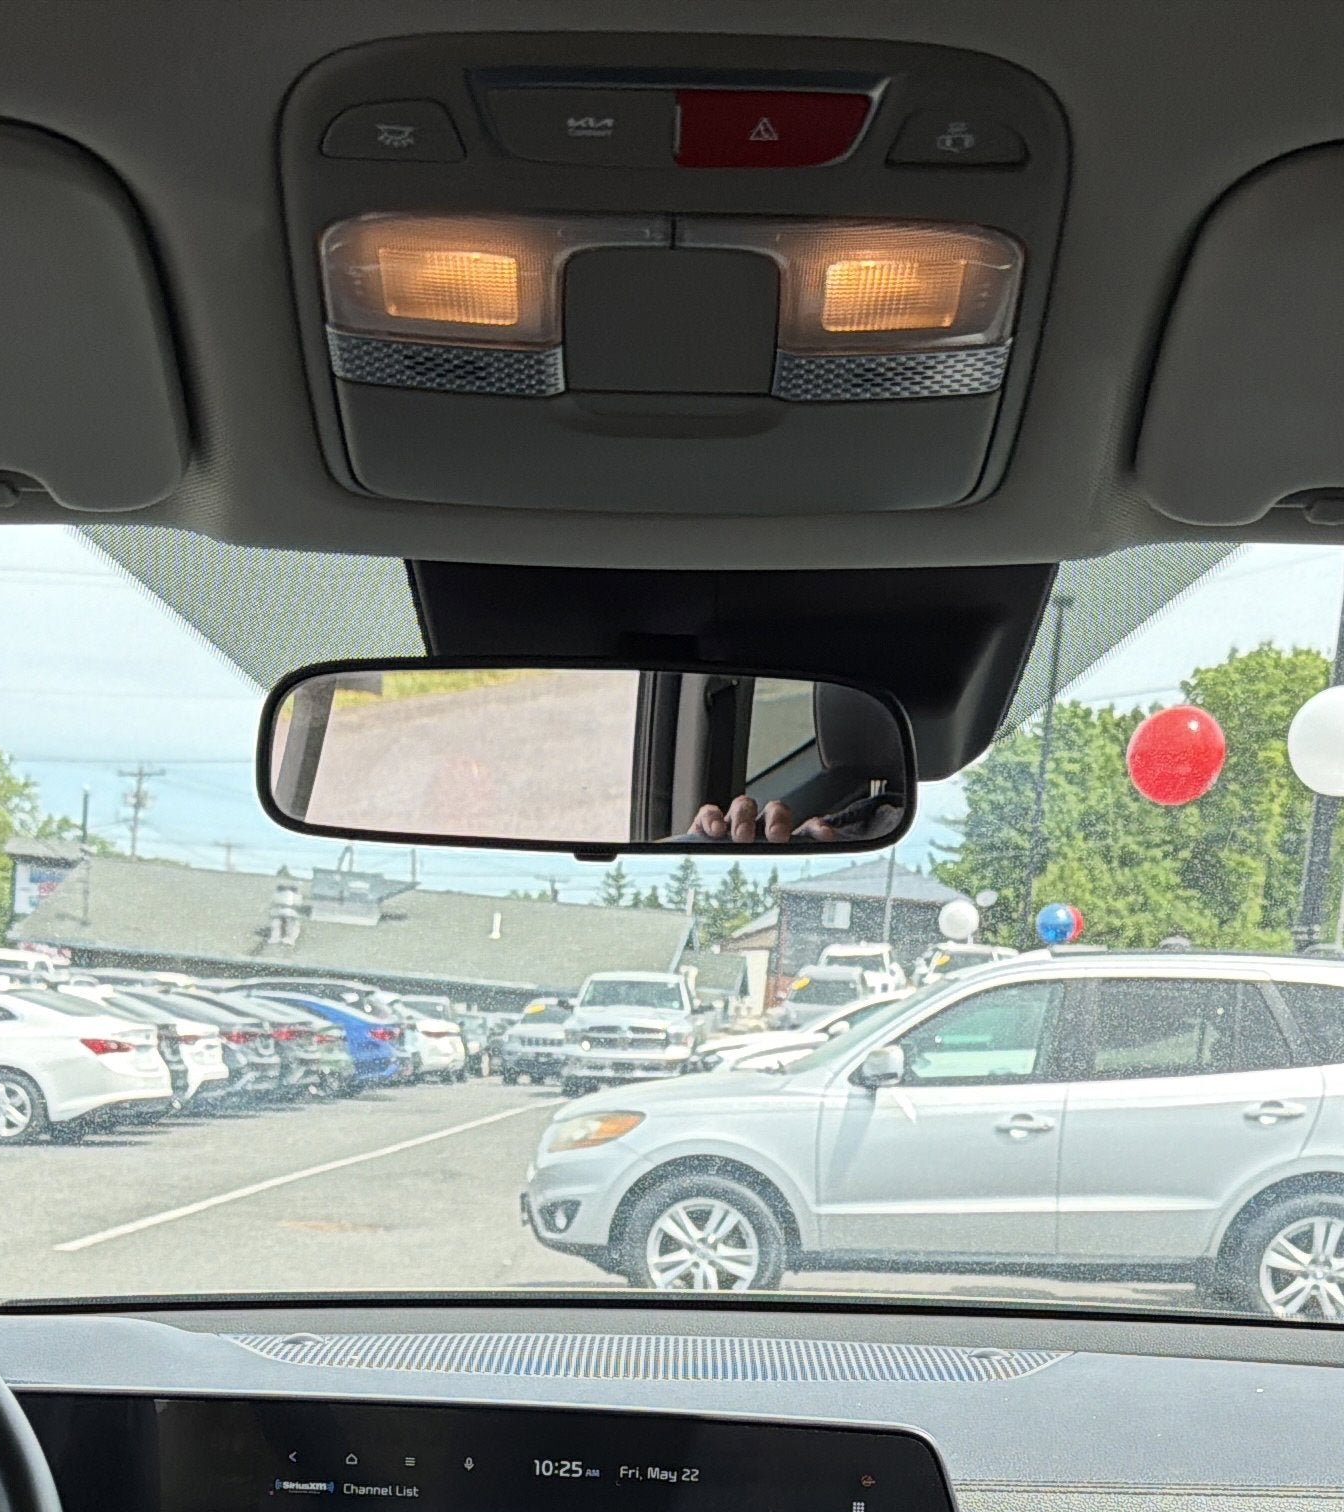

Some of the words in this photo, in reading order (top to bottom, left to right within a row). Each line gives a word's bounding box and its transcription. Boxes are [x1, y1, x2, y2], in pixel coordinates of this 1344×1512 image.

[533, 1459, 583, 1478] 10:25
[585, 1469, 601, 1478] AM
[619, 1465, 643, 1481] Fri,
[647, 1467, 677, 1483] May
[681, 1468, 700, 1482] 22
[343, 1482, 392, 1496] Channel
[395, 1485, 420, 1498] List
